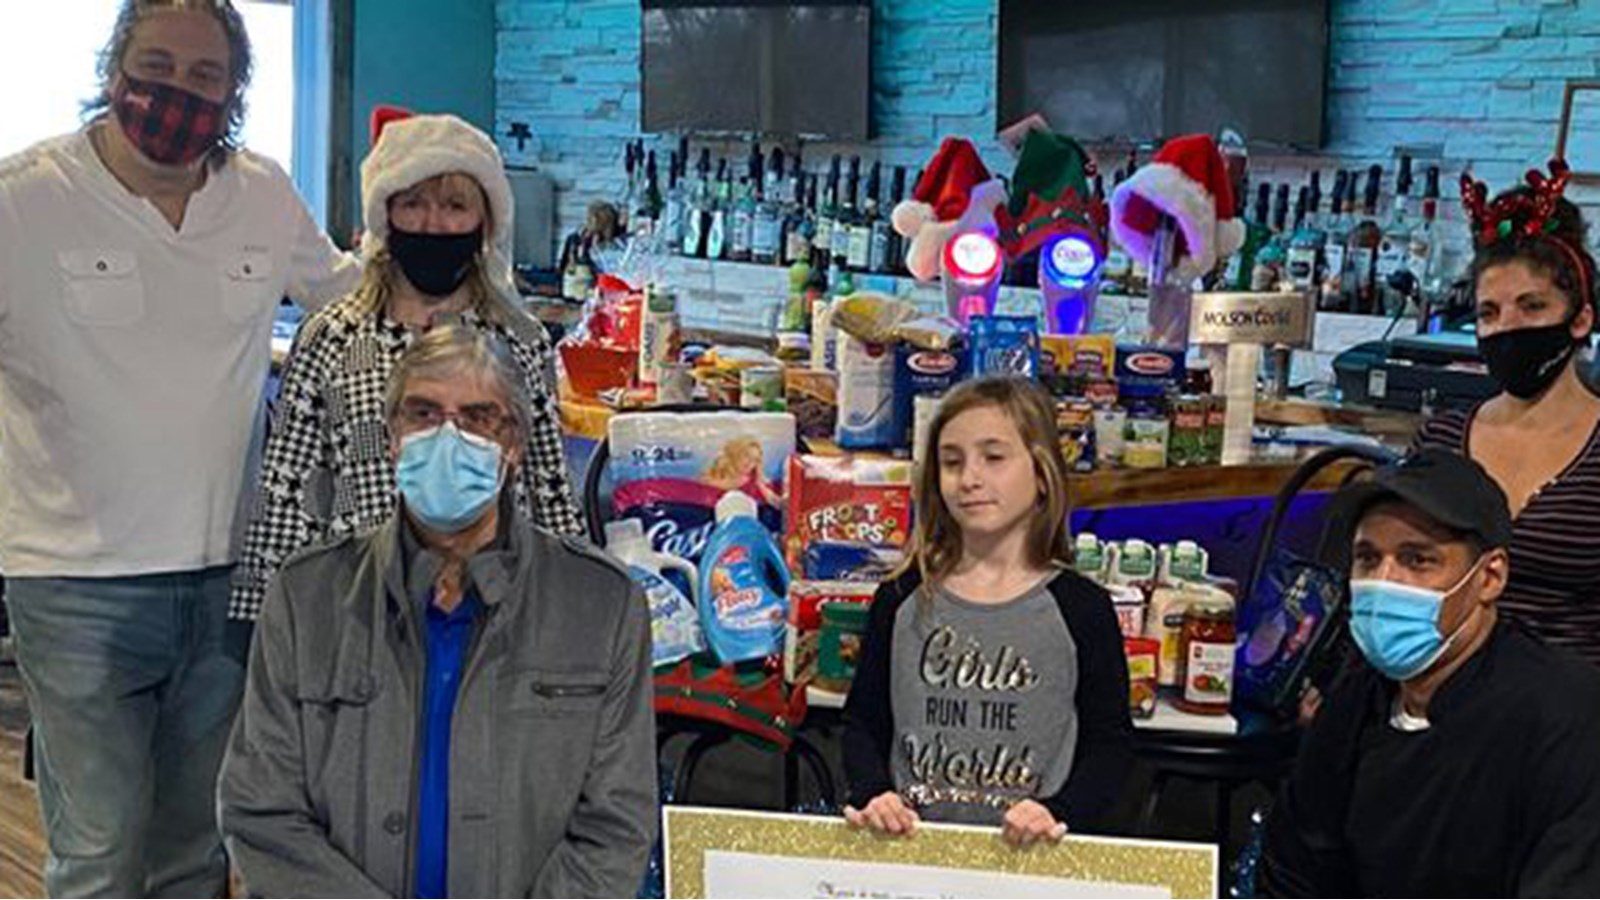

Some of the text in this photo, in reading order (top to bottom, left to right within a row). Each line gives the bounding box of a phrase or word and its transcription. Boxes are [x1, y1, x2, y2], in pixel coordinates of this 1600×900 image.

[920, 624, 1041, 693] Girls
[926, 697, 1018, 731] RUN THE
[904, 731, 1034, 790] World
